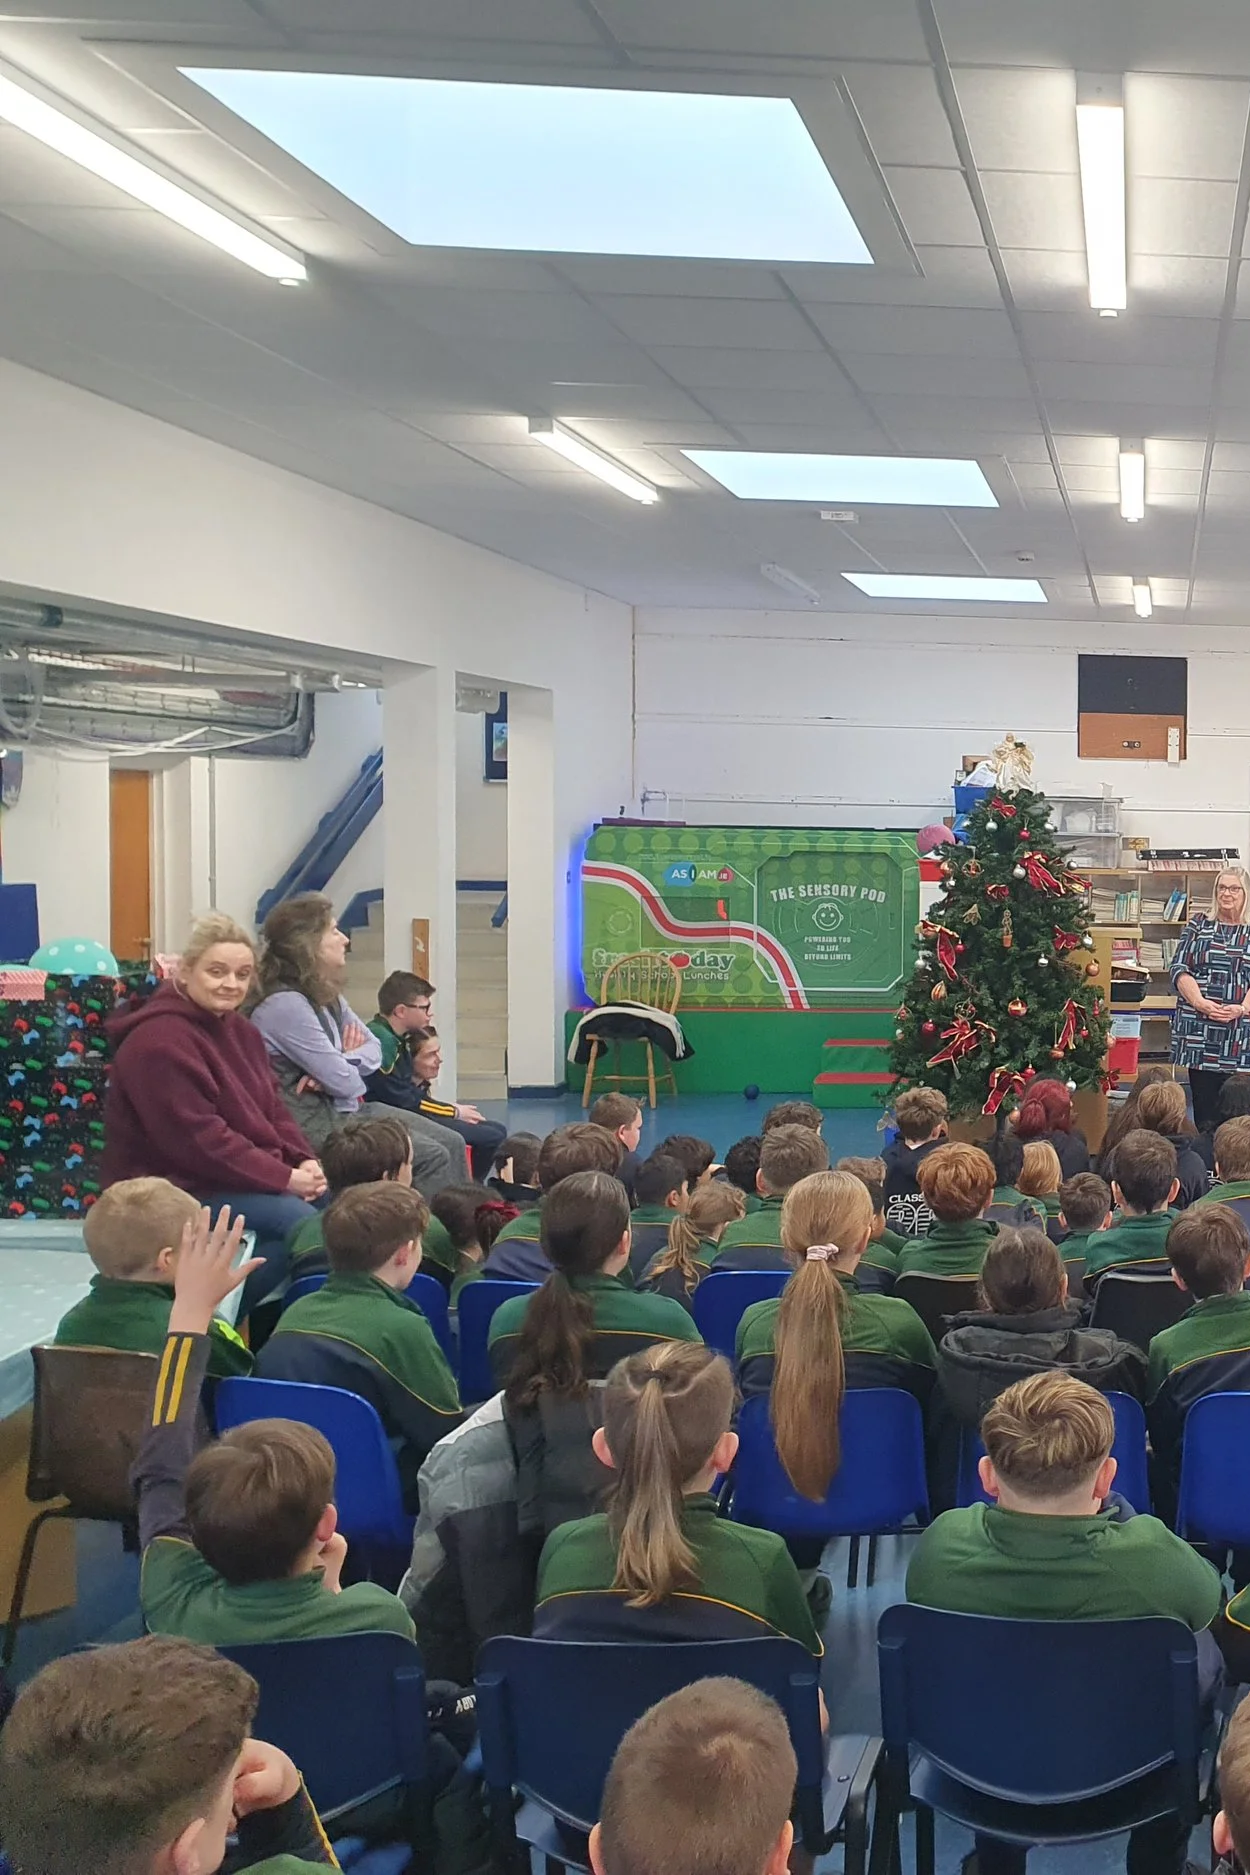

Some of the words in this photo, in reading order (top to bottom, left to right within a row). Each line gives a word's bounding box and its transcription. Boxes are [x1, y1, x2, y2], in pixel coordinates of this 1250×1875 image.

[672, 869, 688, 879] AS
[698, 870, 717, 880] AM
[770, 887, 795, 902] THE
[798, 884, 857, 898] SENSORY
[860, 887, 886, 903] POD
[684, 972, 729, 980] Lunches
[889, 1193, 925, 1203] CLASS
